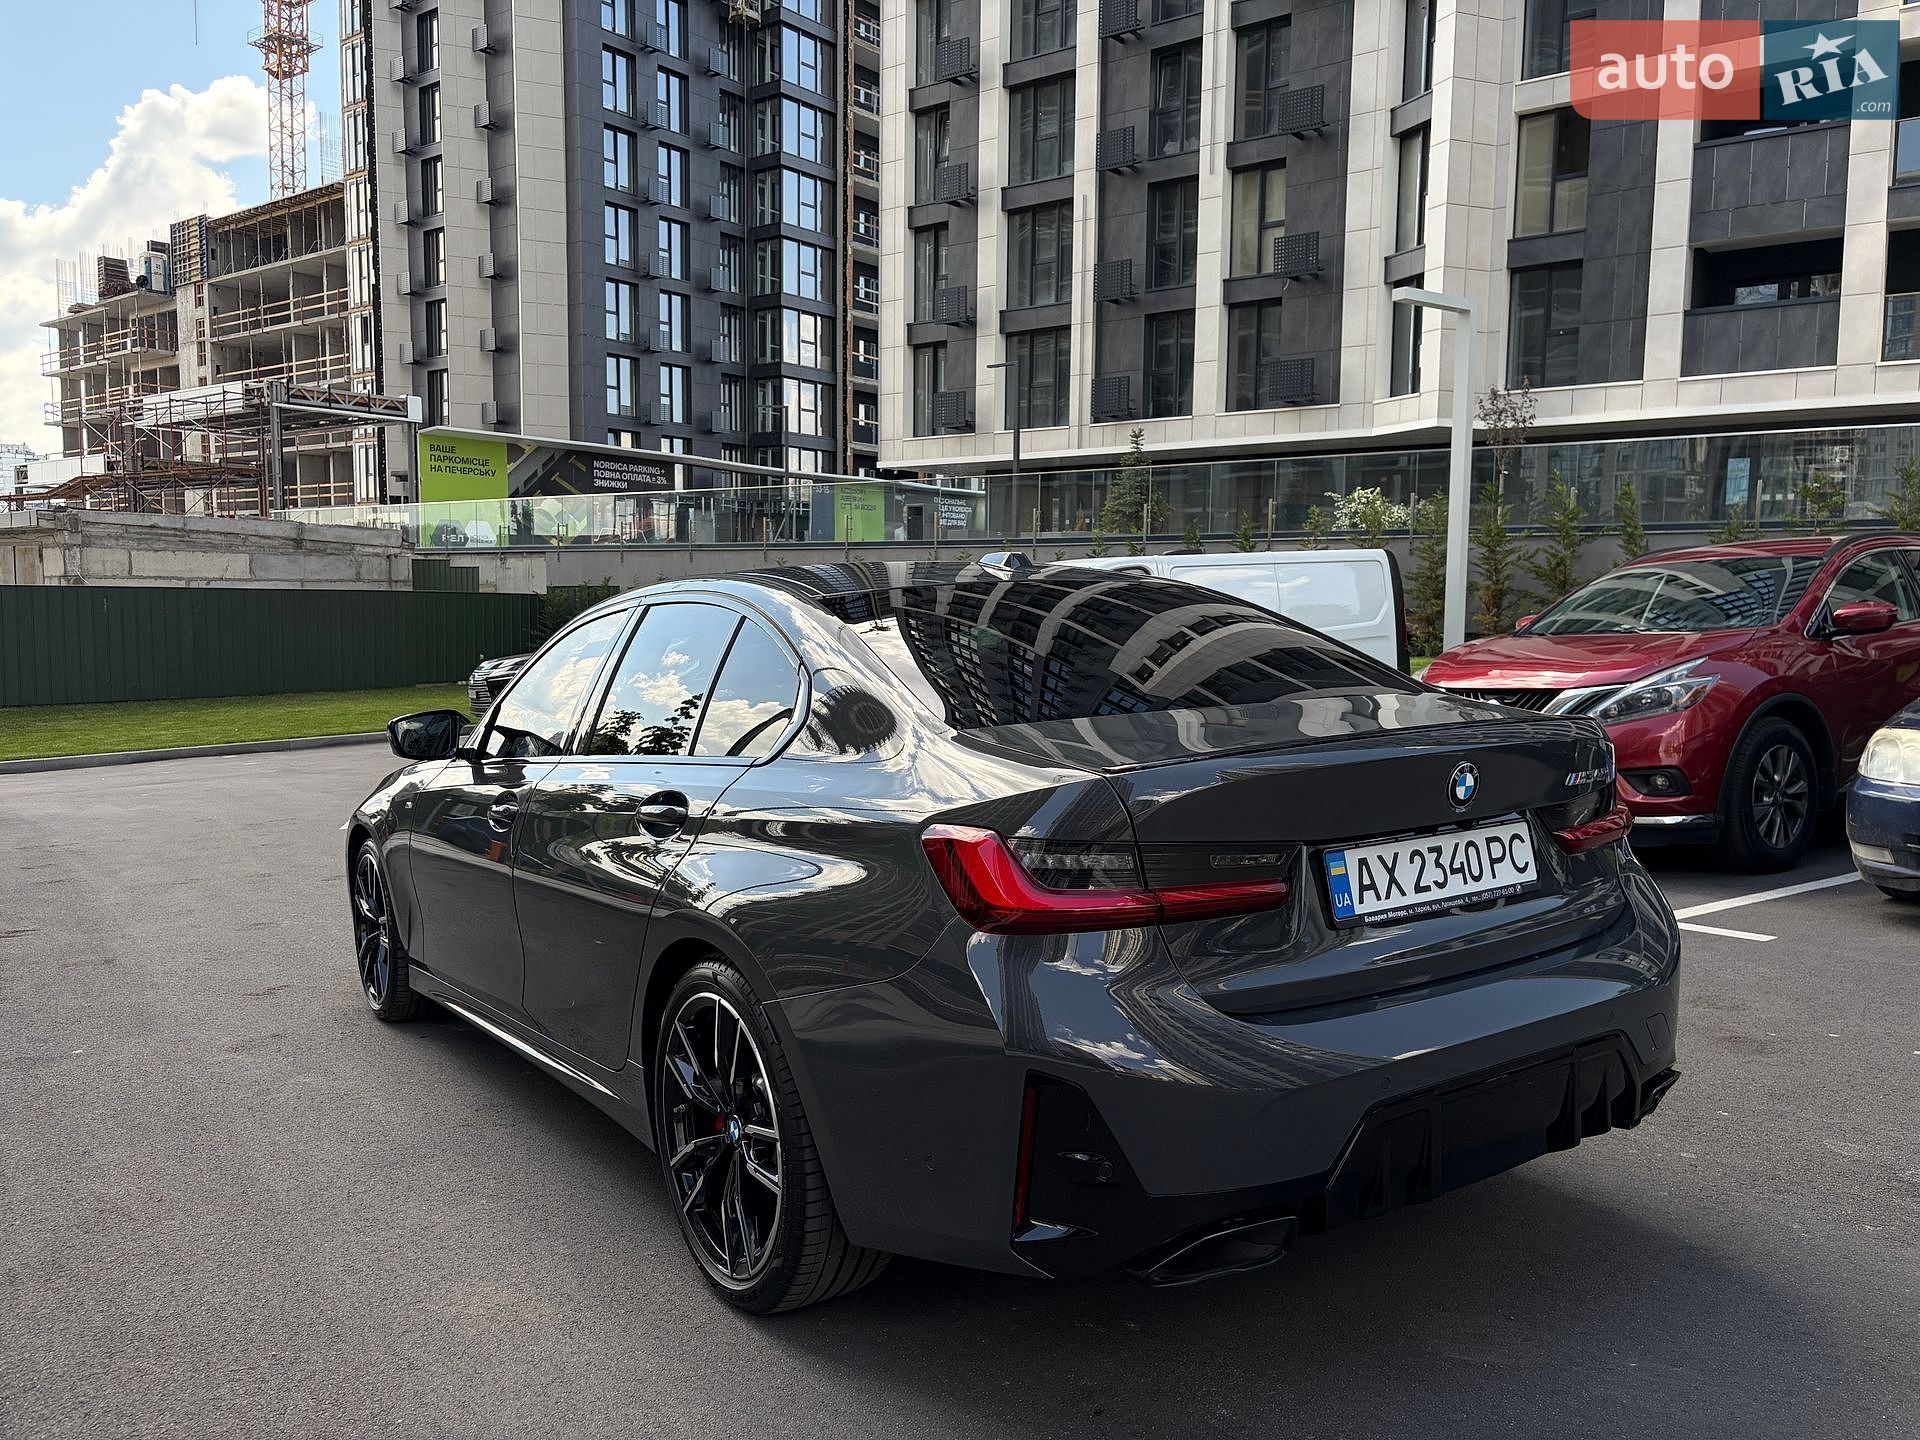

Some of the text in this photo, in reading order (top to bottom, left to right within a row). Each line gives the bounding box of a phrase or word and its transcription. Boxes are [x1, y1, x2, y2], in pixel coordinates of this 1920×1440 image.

[429, 443, 457, 454] ВАШЕ
[429, 454, 491, 468] ПАРКОМІСЦЕ
[593, 460, 628, 472] NORDICA
[629, 464, 660, 475] PARKING
[430, 464, 497, 478] НА ПЕЧЕРСЬКУ
[593, 469, 621, 480] ПОВНА
[621, 472, 651, 483] ОПЛАТА
[593, 478, 628, 489] ЗНИЖКИ
[1357, 832, 1530, 905] AX 2340 PC
[1335, 894, 1352, 908] UA
